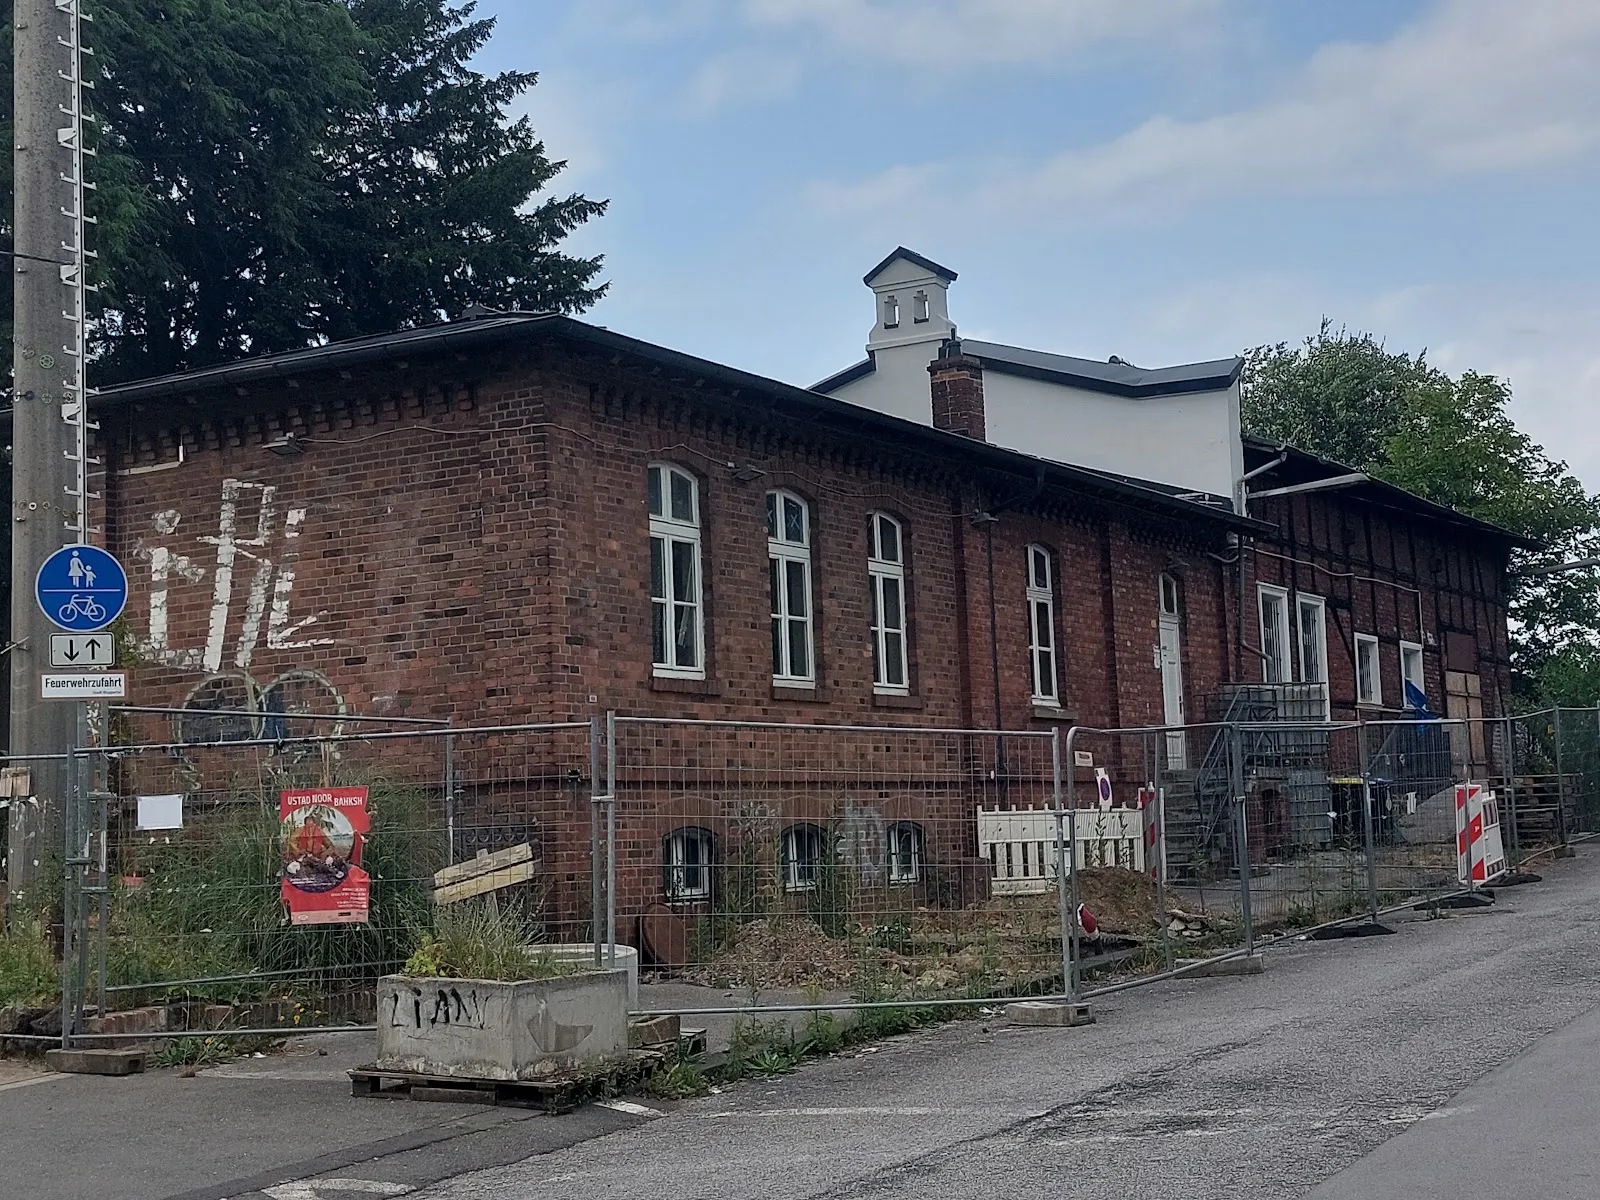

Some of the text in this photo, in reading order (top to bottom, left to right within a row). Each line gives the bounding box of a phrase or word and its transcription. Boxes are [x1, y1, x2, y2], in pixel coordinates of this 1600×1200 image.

[45, 677, 122, 688] Feuerwehrzufahrt
[287, 796, 311, 806] USTAD
[311, 793, 333, 804] NOOR
